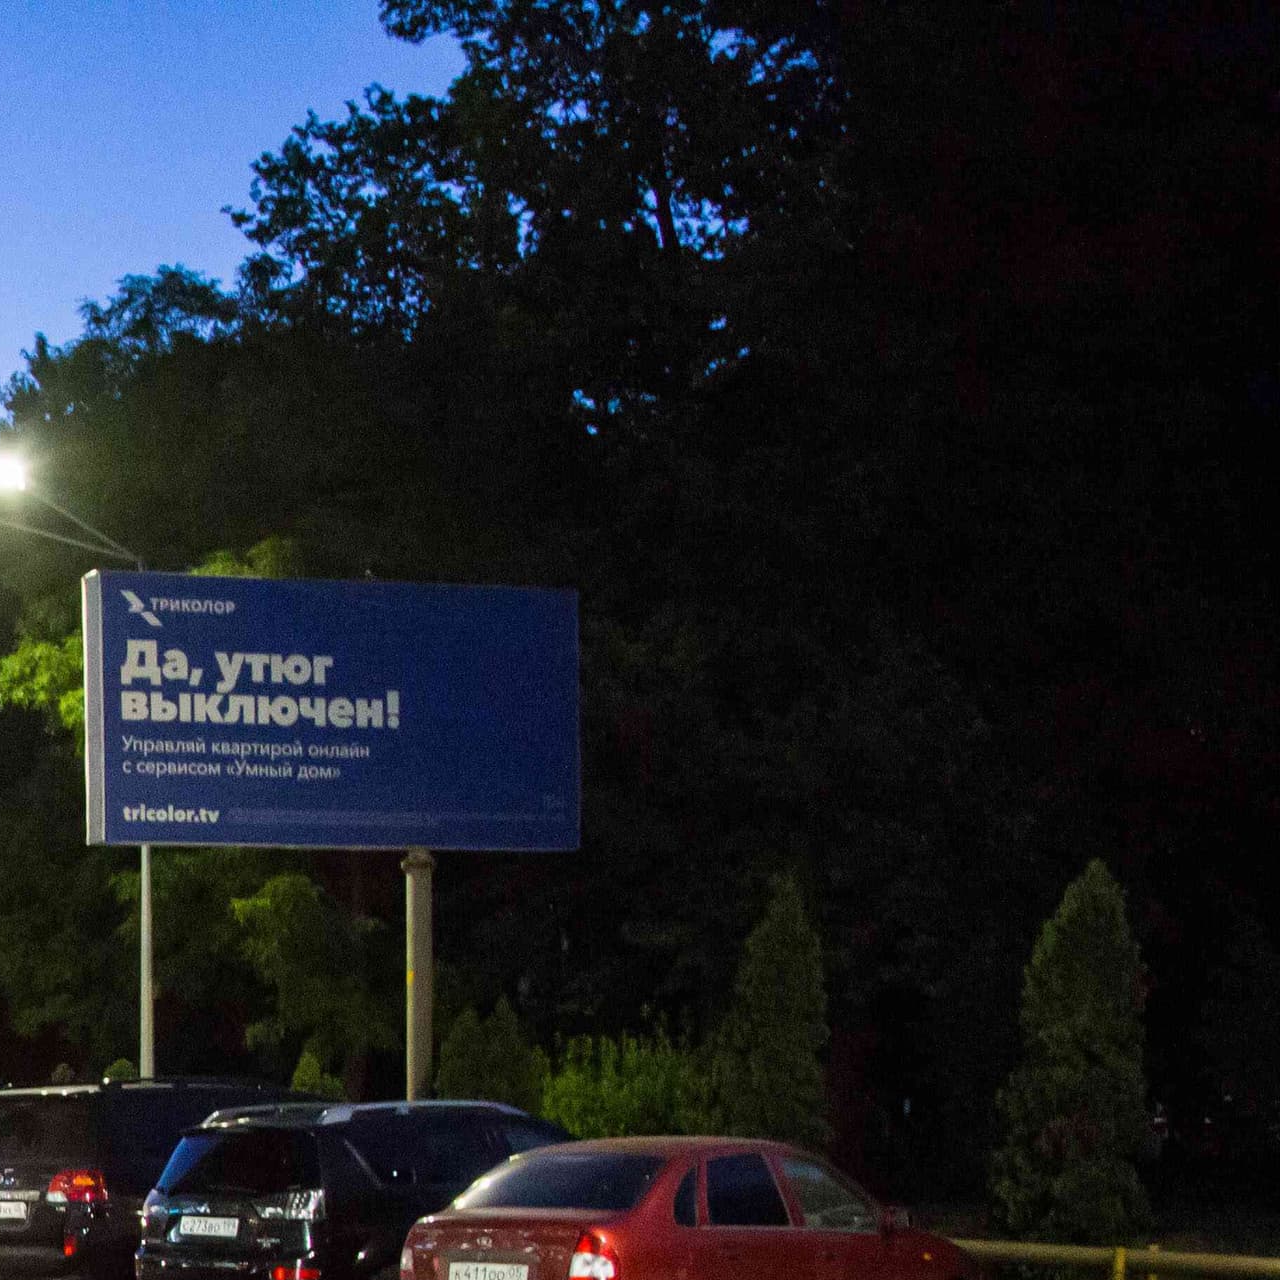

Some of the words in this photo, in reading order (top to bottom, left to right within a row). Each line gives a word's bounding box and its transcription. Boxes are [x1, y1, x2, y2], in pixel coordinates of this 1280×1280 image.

[149, 598, 236, 614] ТРИКОЛОР
[120, 639, 203, 686] Да,
[215, 651, 333, 693] утюг
[121, 690, 400, 729] выключен!
[122, 736, 206, 756] Управляй
[211, 740, 303, 761] квартирой
[308, 743, 370, 758] онлайн
[137, 761, 221, 779] сервисом
[226, 760, 293, 777] «Умный
[297, 766, 341, 781] дом»
[123, 804, 220, 823] tricolor.tv
